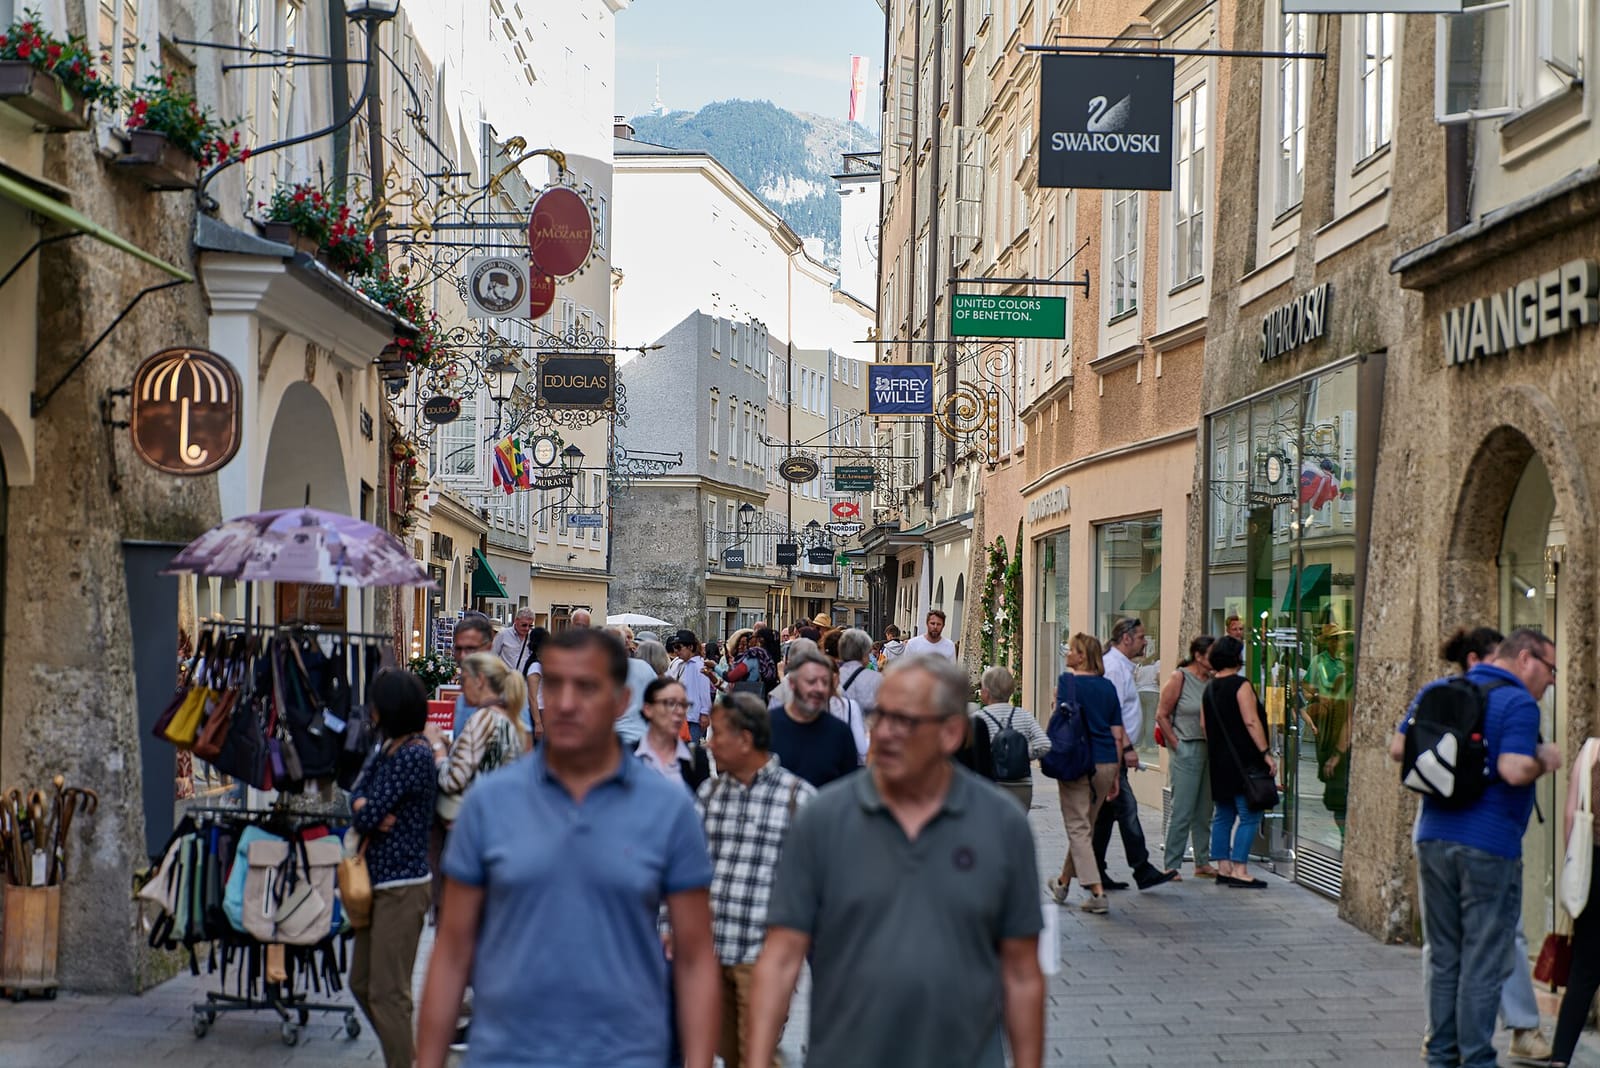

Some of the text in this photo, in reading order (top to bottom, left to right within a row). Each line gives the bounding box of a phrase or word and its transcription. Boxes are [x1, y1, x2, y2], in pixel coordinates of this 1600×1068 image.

[1051, 131, 1160, 153] SWAROVSKI
[541, 228, 590, 240] MOZART
[956, 299, 1041, 310] UNITED COLORS
[956, 310, 1032, 321] OF BENETTON.
[1440, 258, 1597, 367] WANGER
[1259, 282, 1328, 363] SWAROVSKI
[544, 375, 607, 389] DOUGLAS
[890, 378, 929, 391] FREY
[875, 391, 925, 403] WILLE
[425, 405, 458, 414] DOUGLAS
[535, 477, 569, 487] AURANT
